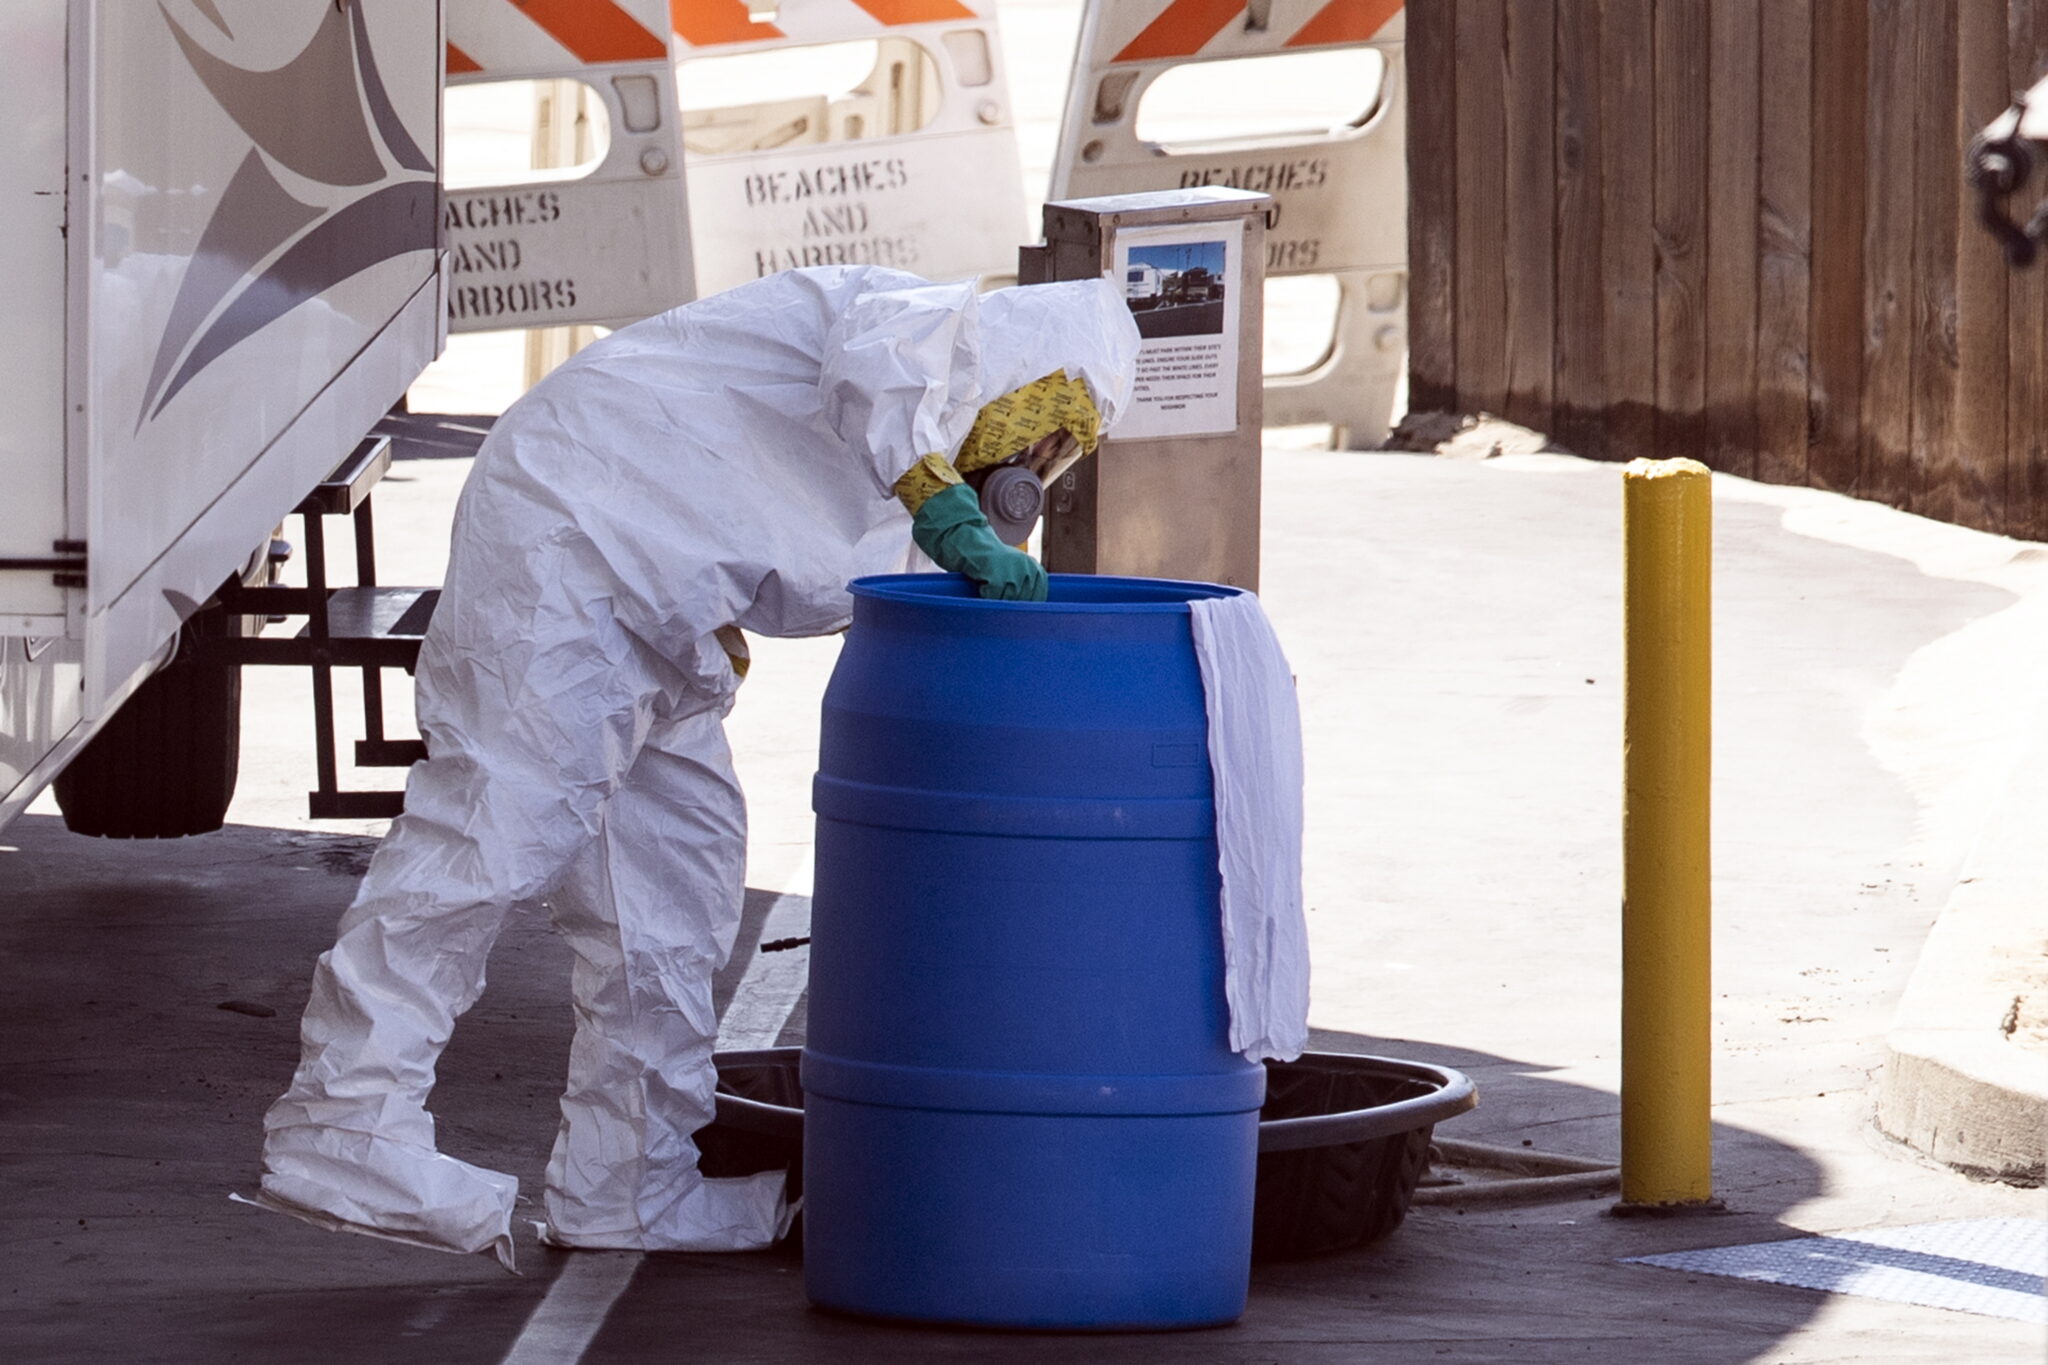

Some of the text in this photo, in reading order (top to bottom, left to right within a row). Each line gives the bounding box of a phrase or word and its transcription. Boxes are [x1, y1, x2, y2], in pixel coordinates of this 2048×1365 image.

[744, 159, 908, 206] BEACHES
[1179, 158, 1328, 191] BEACHES
[444, 191, 560, 230] ACHES
[802, 202, 868, 238] AND
[453, 239, 521, 274] AND
[755, 236, 920, 278] HARBORS
[448, 279, 576, 319] ARBORS
